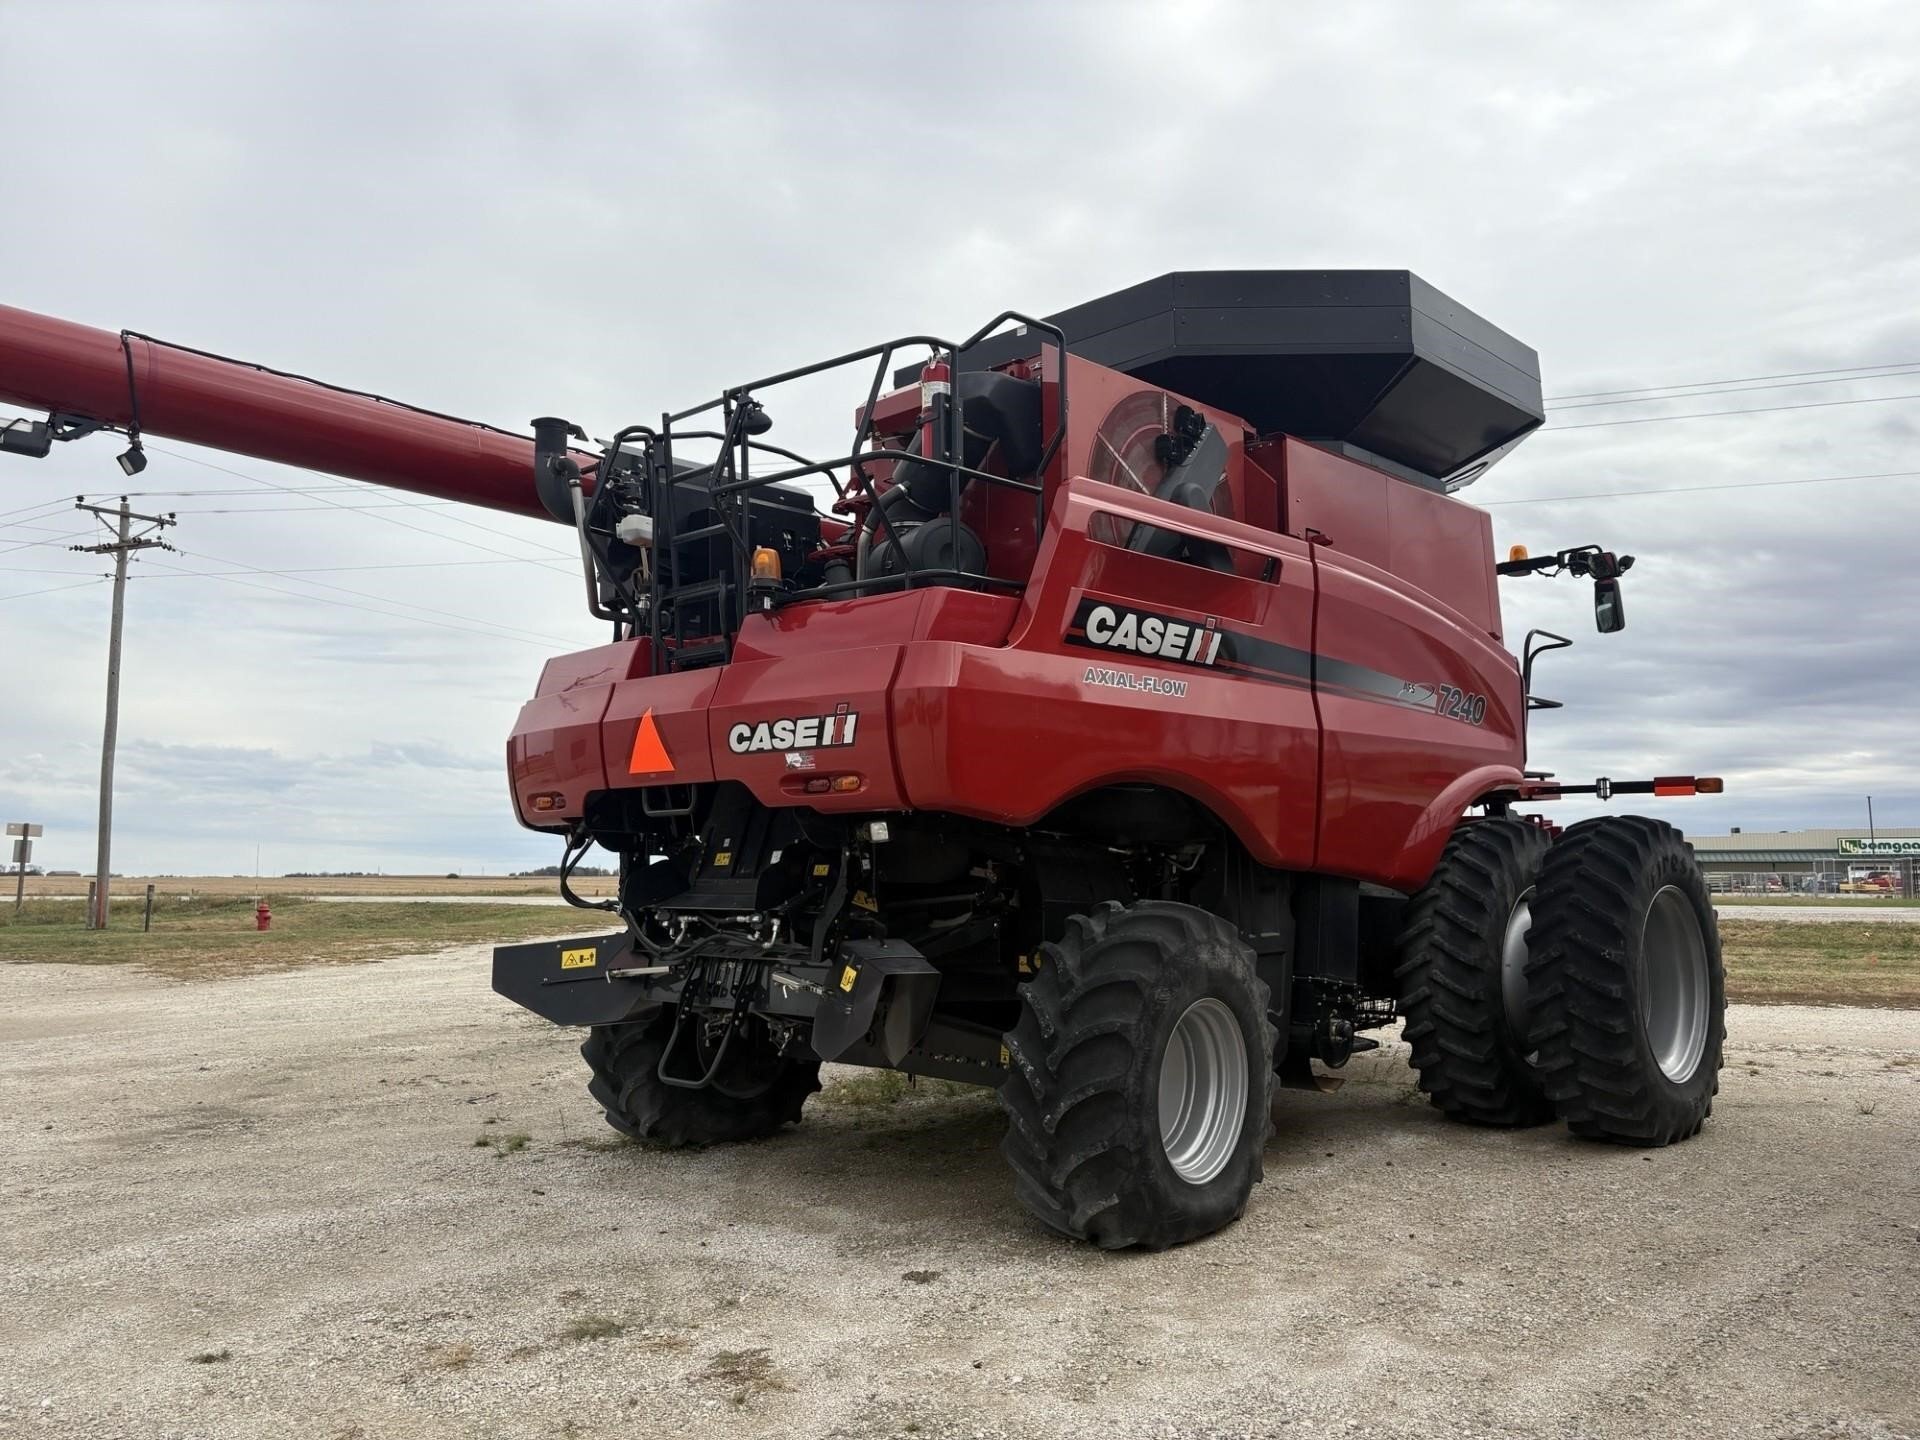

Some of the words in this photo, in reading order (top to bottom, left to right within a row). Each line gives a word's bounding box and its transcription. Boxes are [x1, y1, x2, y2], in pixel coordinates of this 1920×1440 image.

[1086, 606, 1190, 659] CASE
[1083, 667, 1188, 697] AXIAL-FLOW
[1438, 683, 1487, 725] 7240
[729, 718, 820, 753] CASE
